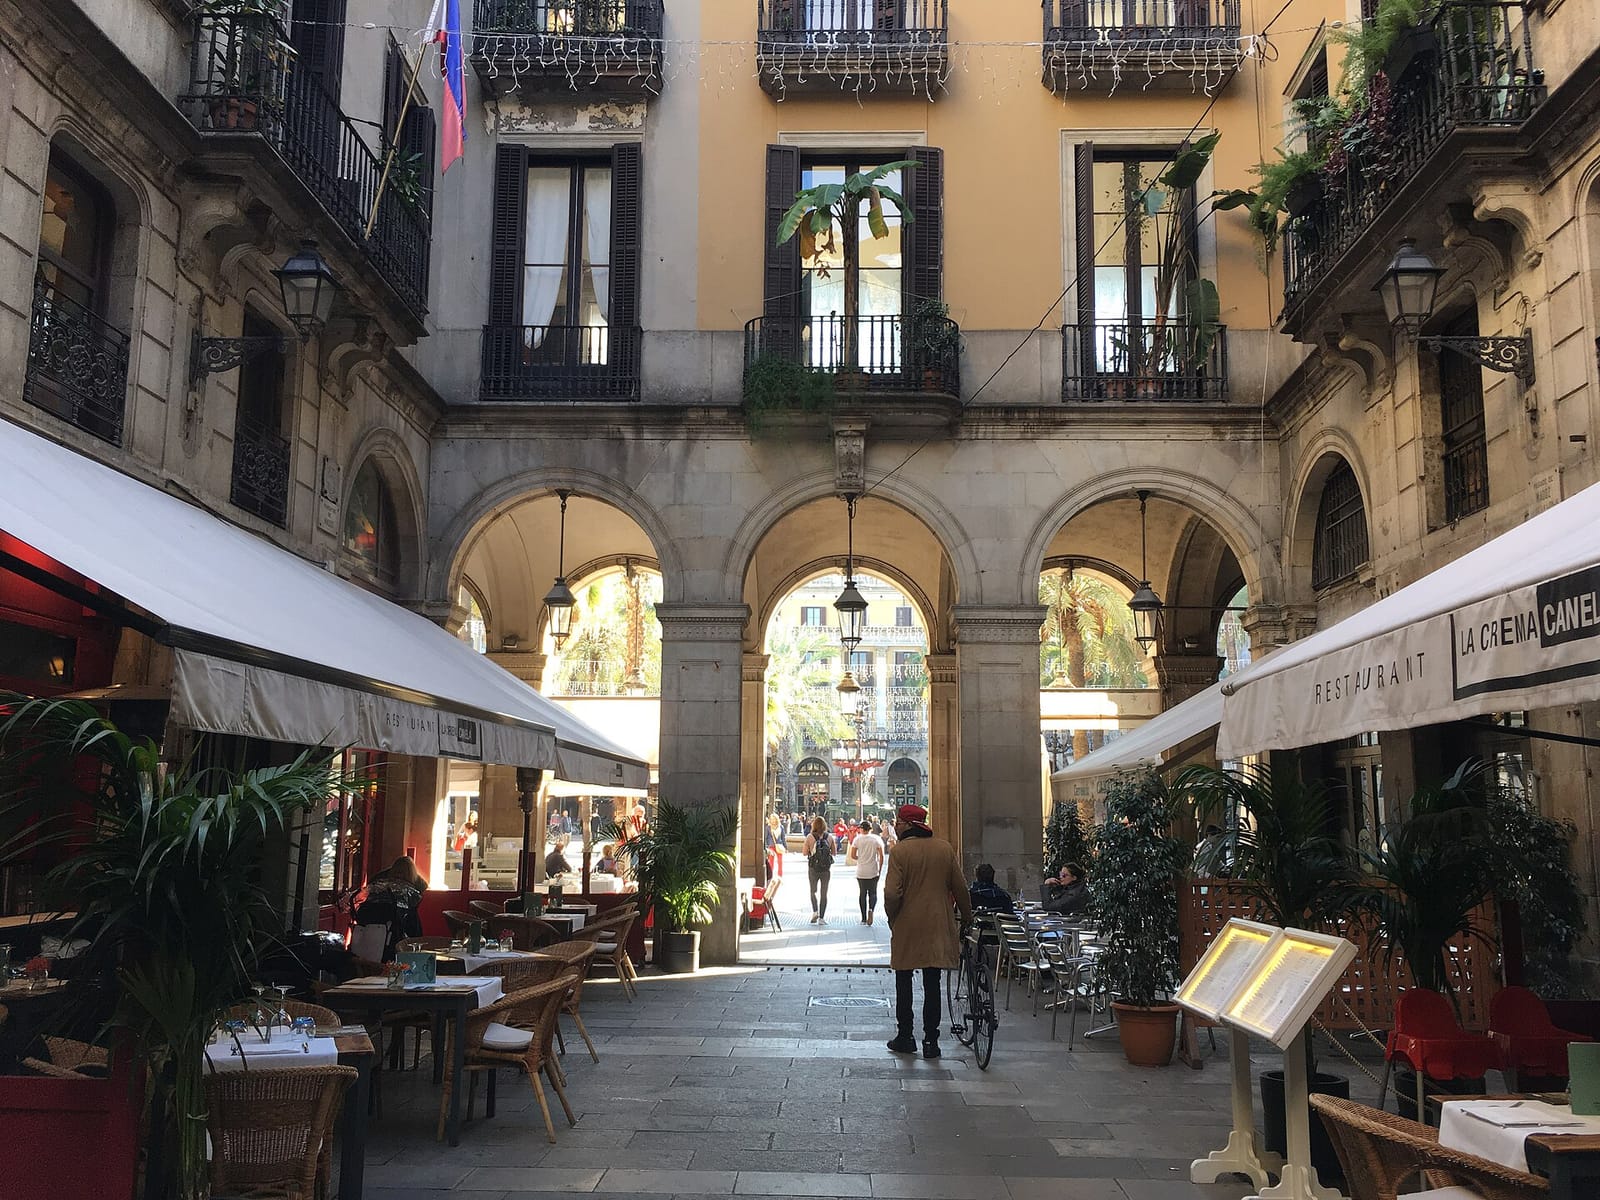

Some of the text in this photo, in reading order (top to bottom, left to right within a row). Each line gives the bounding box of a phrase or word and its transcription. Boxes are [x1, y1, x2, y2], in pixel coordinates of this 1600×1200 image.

[1460, 591, 1600, 657] LA CREMA CANEL
[1315, 652, 1425, 705] RESTAURANT
